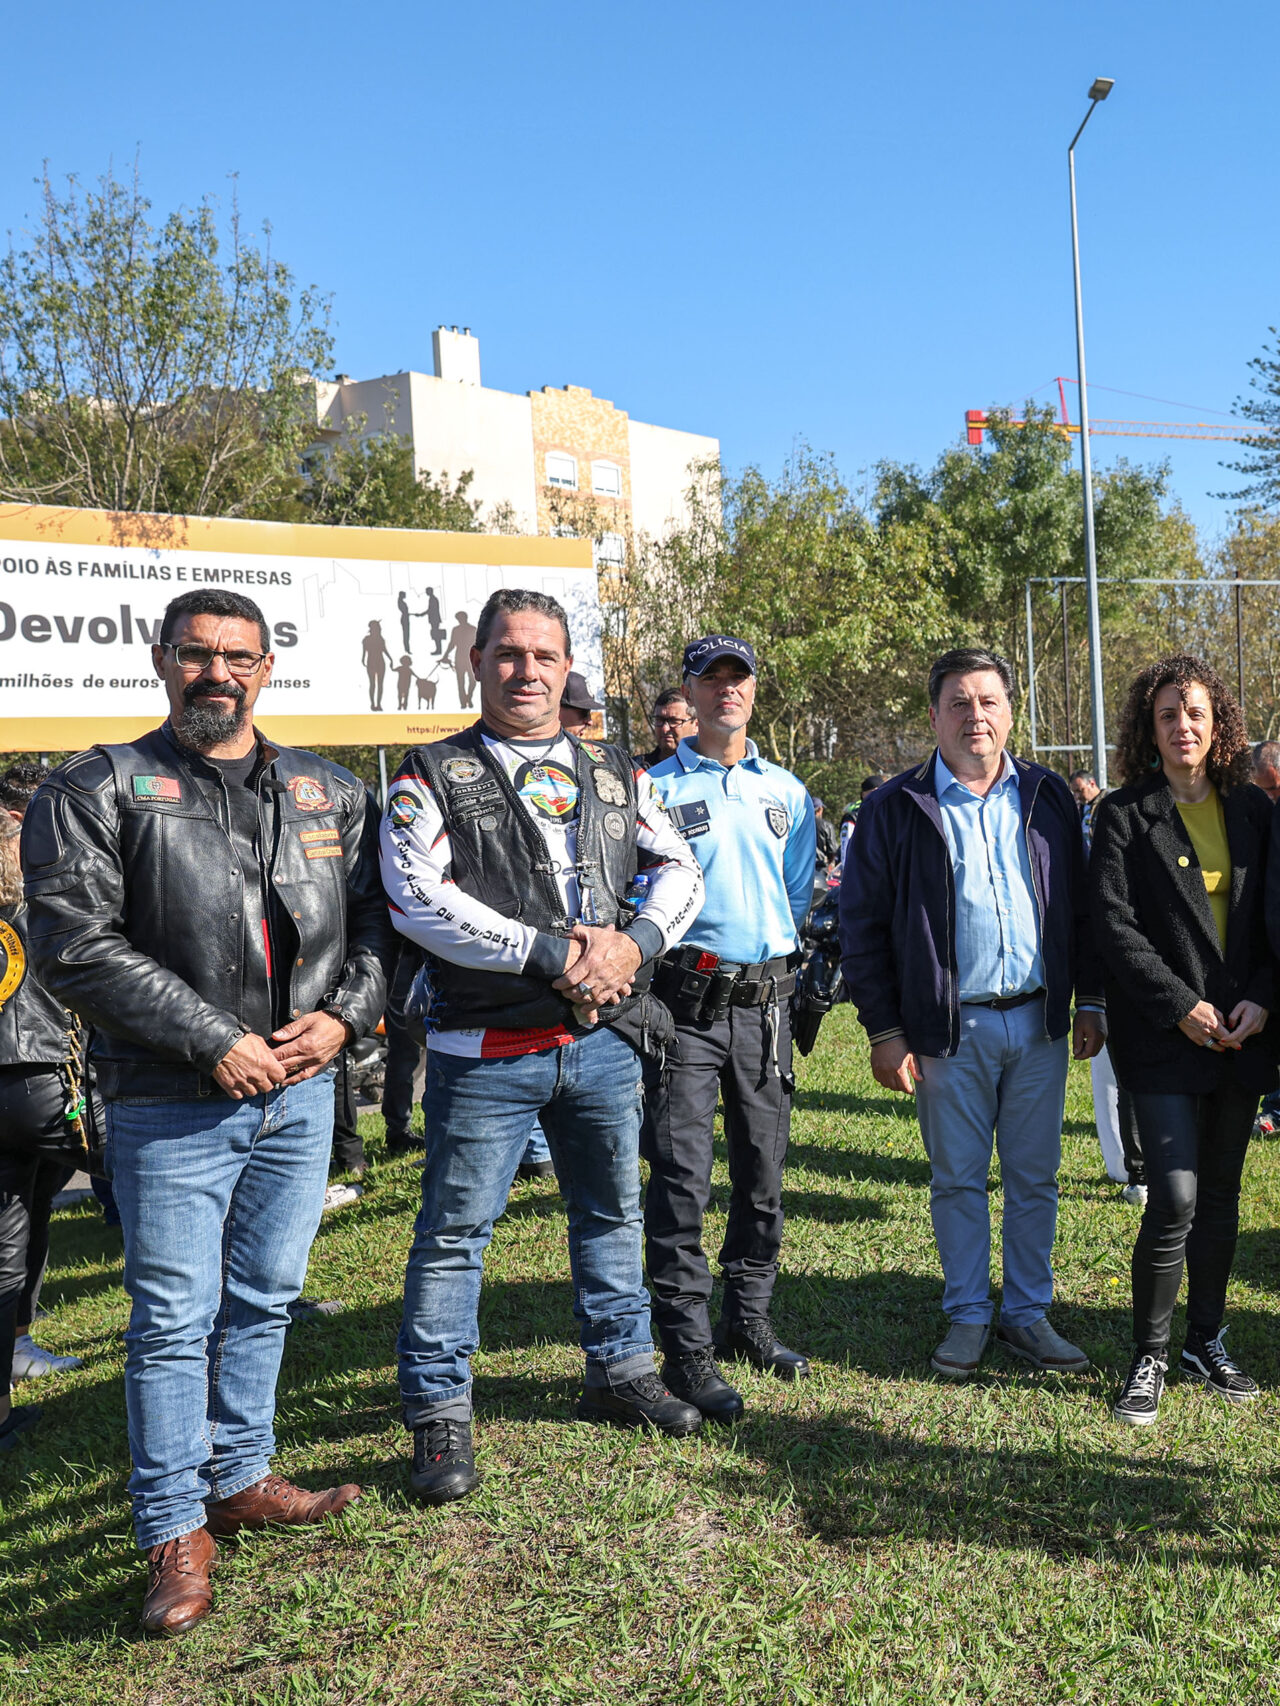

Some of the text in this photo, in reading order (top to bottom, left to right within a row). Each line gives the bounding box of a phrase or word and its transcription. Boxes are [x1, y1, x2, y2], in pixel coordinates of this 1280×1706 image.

[0, 556, 293, 586] OIO ÀS FAMÍLIAS E EMPRESAS
[688, 638, 750, 661] POLÍCIA
[0, 673, 74, 688] milhões
[83, 674, 105, 688] de
[109, 677, 160, 688] euros
[436, 906, 456, 922] DE
